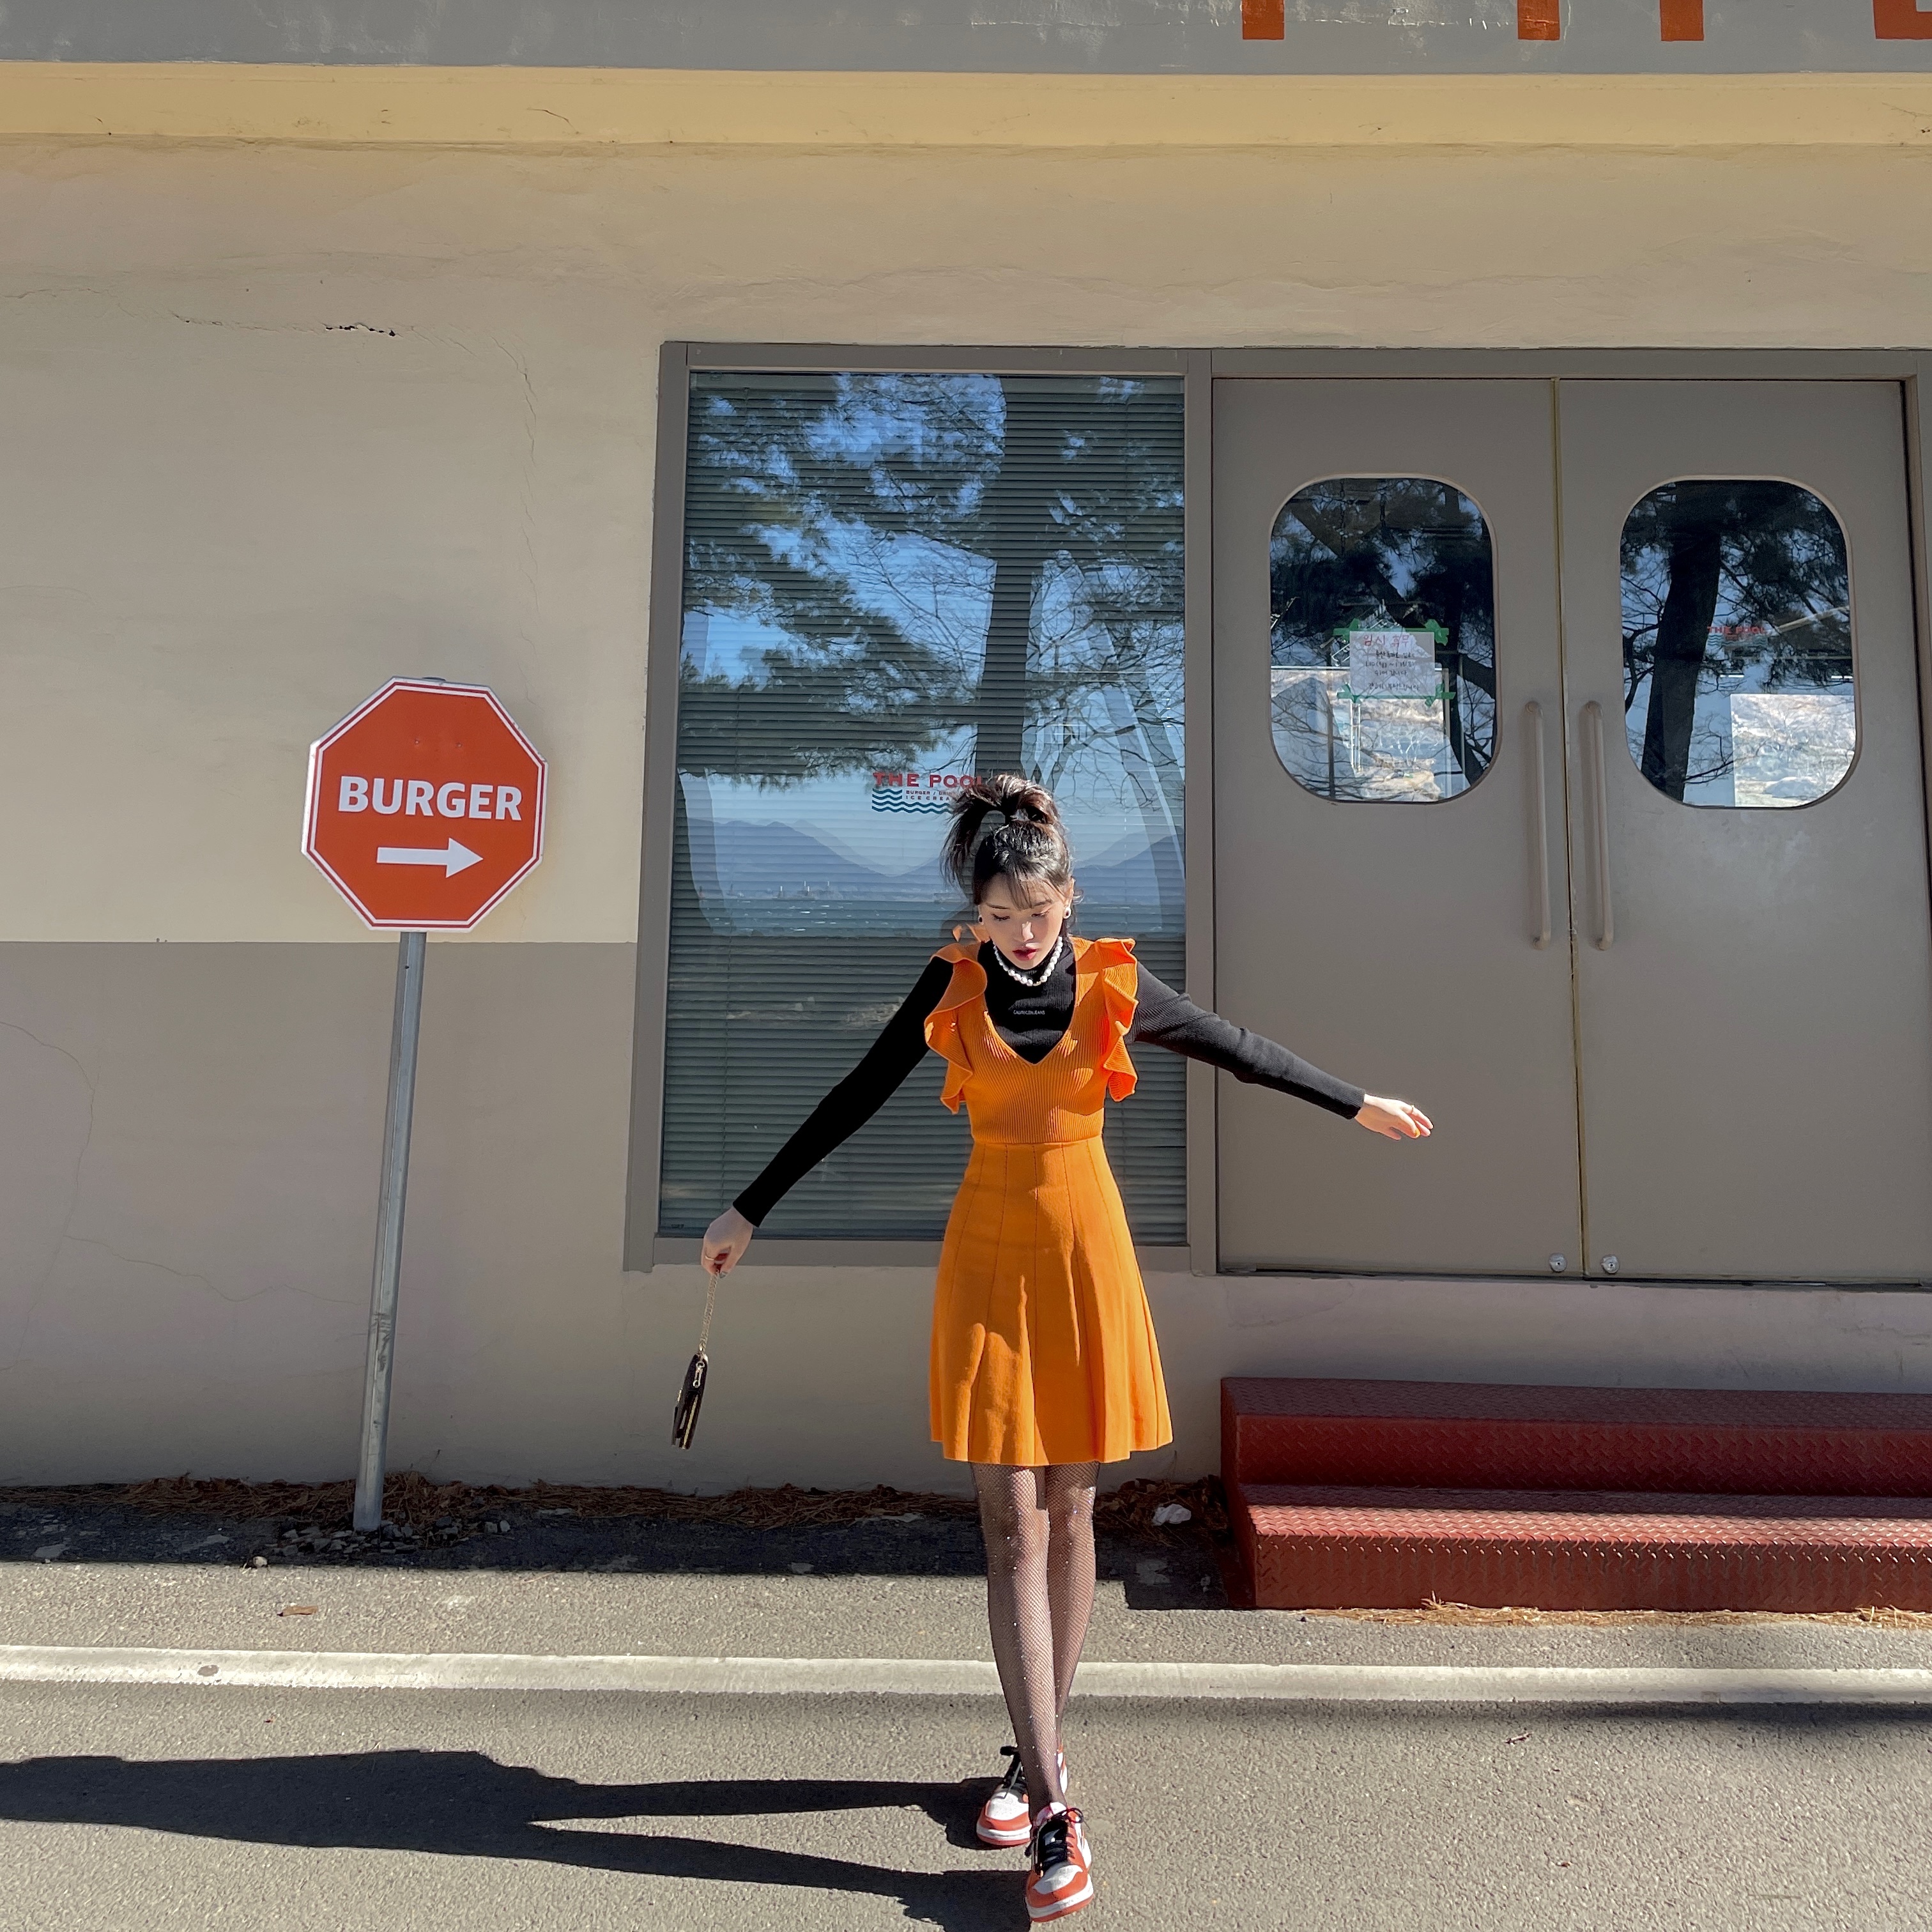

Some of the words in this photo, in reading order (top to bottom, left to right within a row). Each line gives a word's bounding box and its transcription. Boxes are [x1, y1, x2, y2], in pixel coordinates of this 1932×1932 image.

[1707, 626, 1731, 634] THE
[1363, 634, 1385, 646] 임시
[1392, 634, 1409, 648] 휴무
[873, 772, 920, 787] THE
[338, 775, 522, 821] BURGER
